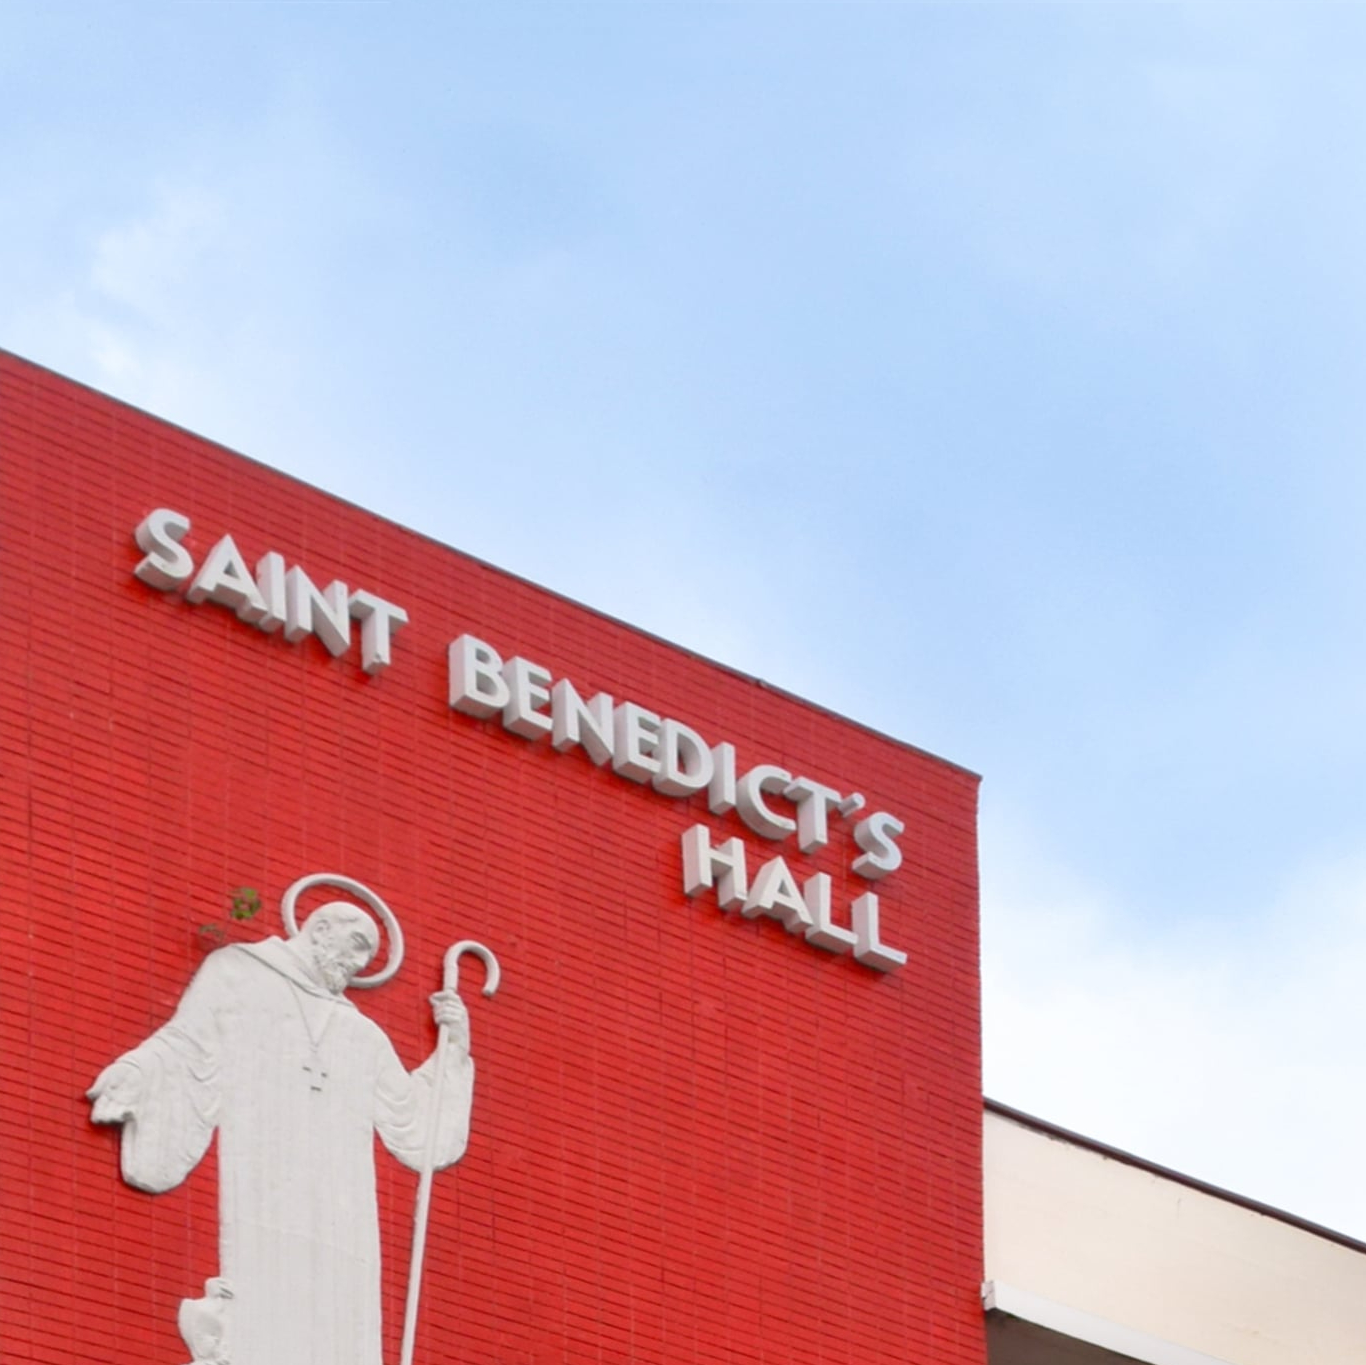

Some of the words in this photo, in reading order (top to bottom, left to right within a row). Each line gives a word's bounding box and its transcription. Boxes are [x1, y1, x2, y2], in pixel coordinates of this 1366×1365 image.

[133, 508, 409, 676] SAINT
[448, 633, 905, 880] BENEDICT'S
[681, 823, 907, 972] HALL
